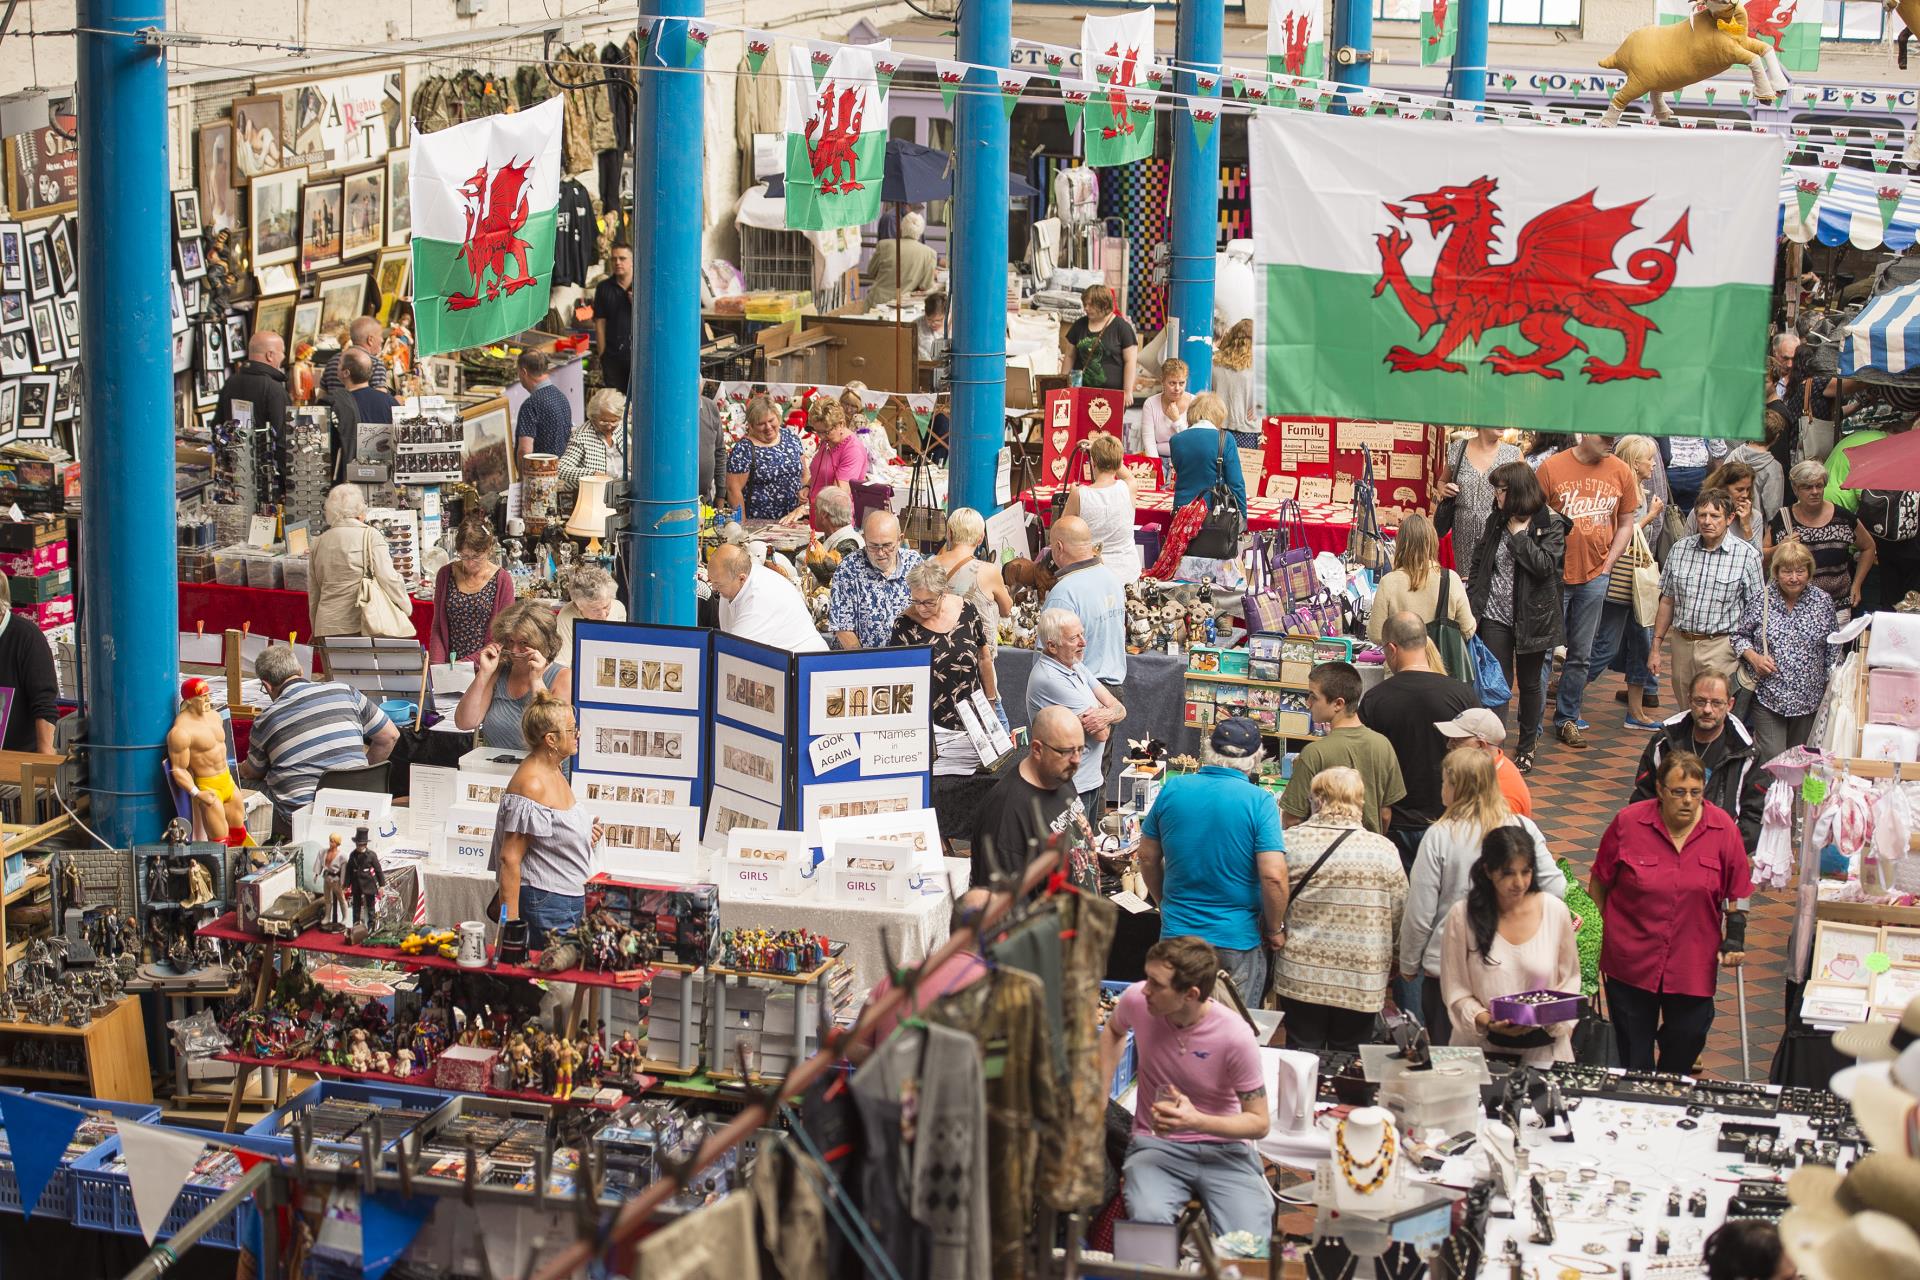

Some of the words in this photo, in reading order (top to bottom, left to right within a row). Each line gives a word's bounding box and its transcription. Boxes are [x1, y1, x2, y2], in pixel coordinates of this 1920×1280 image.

[1287, 424, 1325, 438] Family
[1313, 491, 1330, 499] Room
[1585, 478, 1623, 498] STREET
[1559, 489, 1618, 519] Harlem
[825, 684, 914, 718] JACK
[818, 734, 845, 751] LOOK
[820, 748, 852, 768] AGAIN
[458, 846, 485, 858] BOYS
[739, 871, 768, 881] GIRLS
[846, 881, 876, 892] GIRLS
